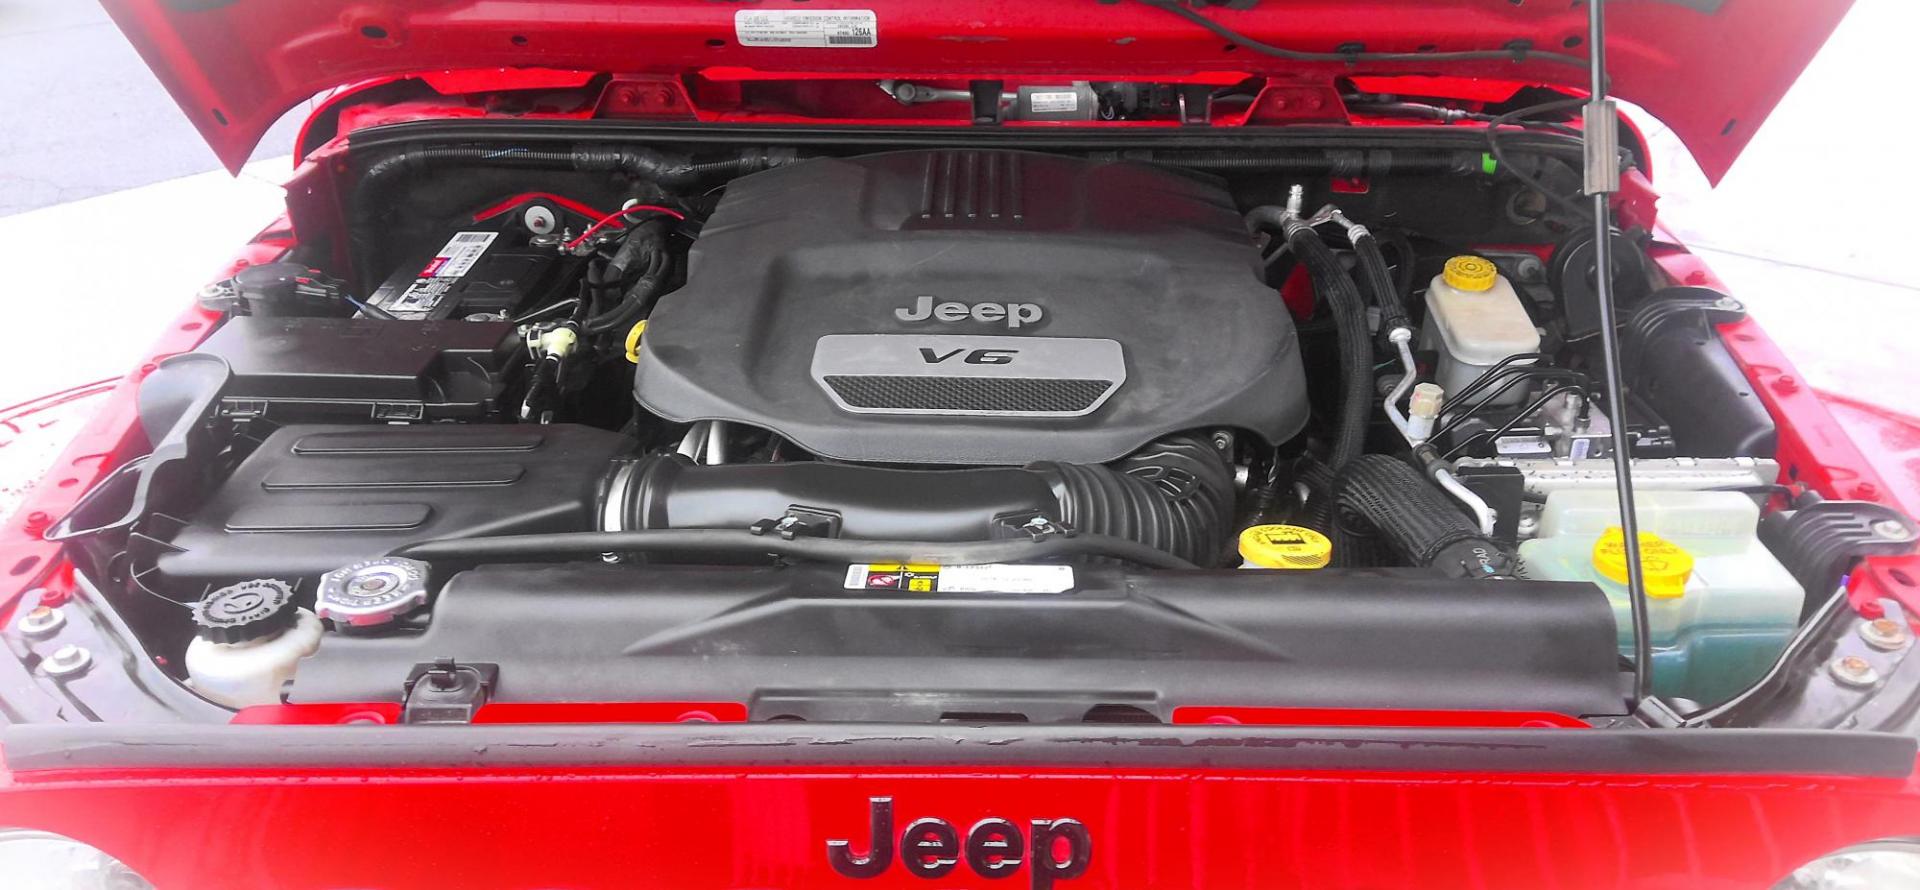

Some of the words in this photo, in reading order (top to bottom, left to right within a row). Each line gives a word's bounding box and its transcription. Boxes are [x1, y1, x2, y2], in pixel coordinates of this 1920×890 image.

[895, 296, 1043, 328] Jeep
[918, 348, 1019, 365] V6
[825, 796, 1092, 890] Jeep
